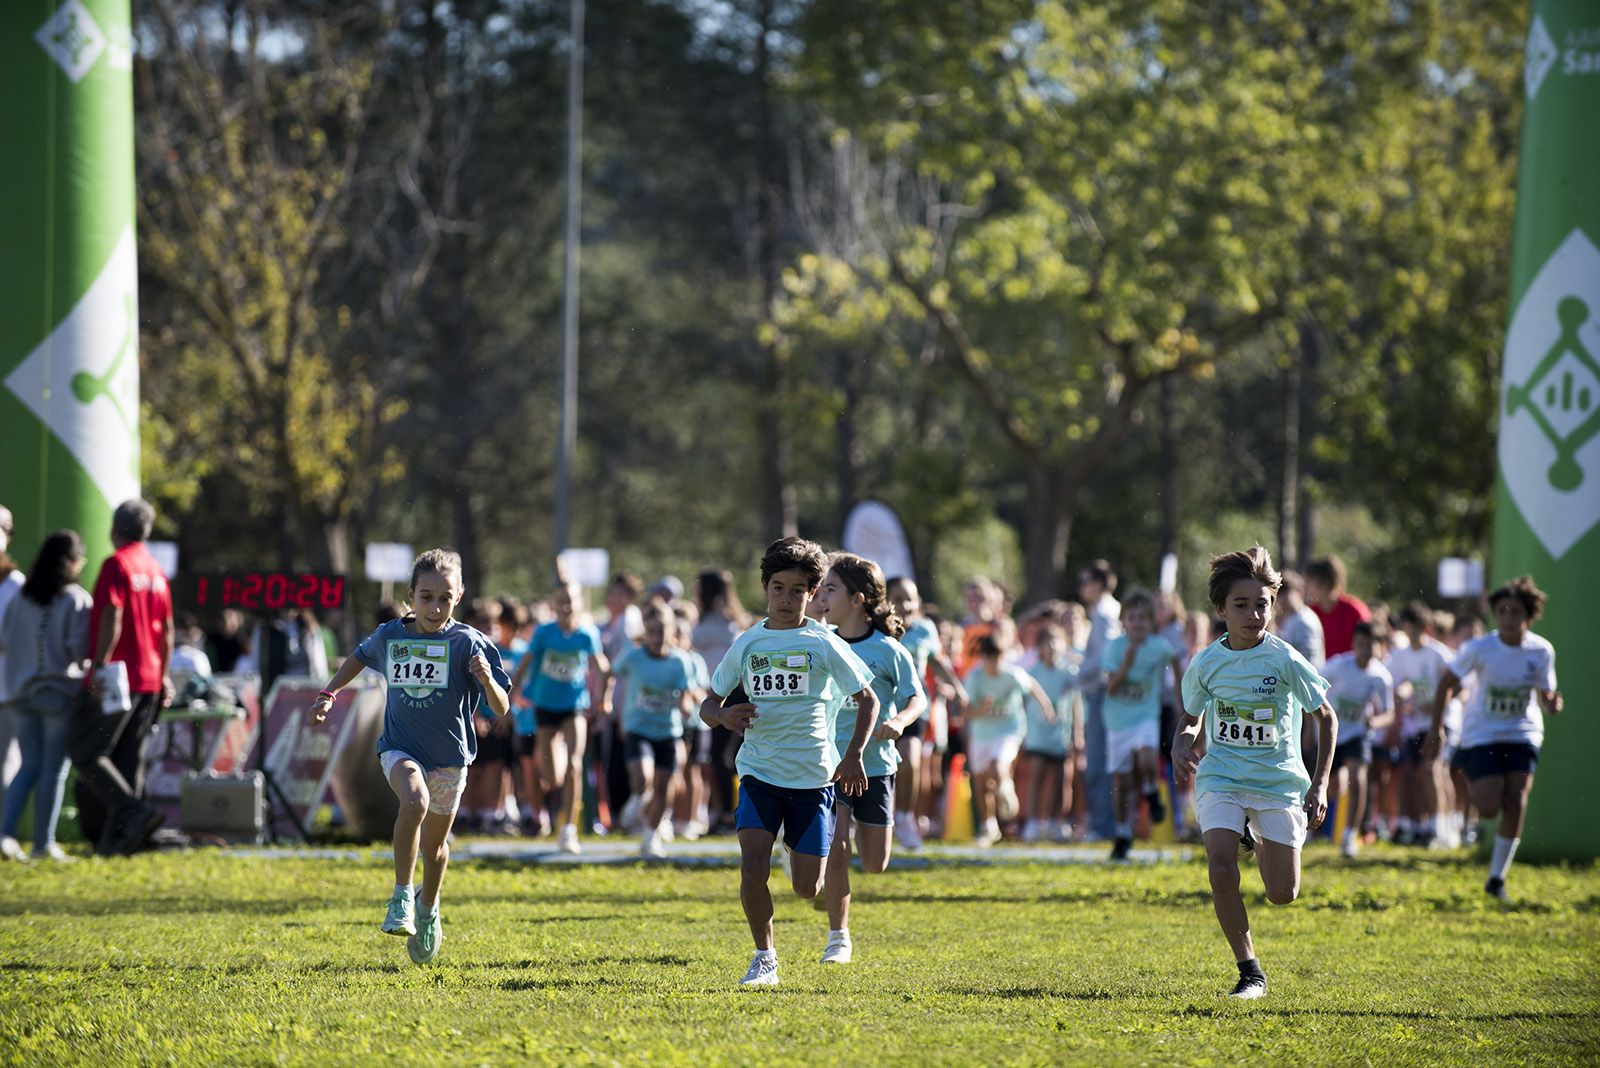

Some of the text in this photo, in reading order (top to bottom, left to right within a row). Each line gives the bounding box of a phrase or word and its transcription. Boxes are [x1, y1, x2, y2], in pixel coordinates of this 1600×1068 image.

[393, 663, 435, 679] 2142
[751, 656, 770, 670] CROS
[753, 673, 799, 691] 2633
[1218, 706, 1236, 715] CROS
[1219, 721, 1264, 741] 2641
